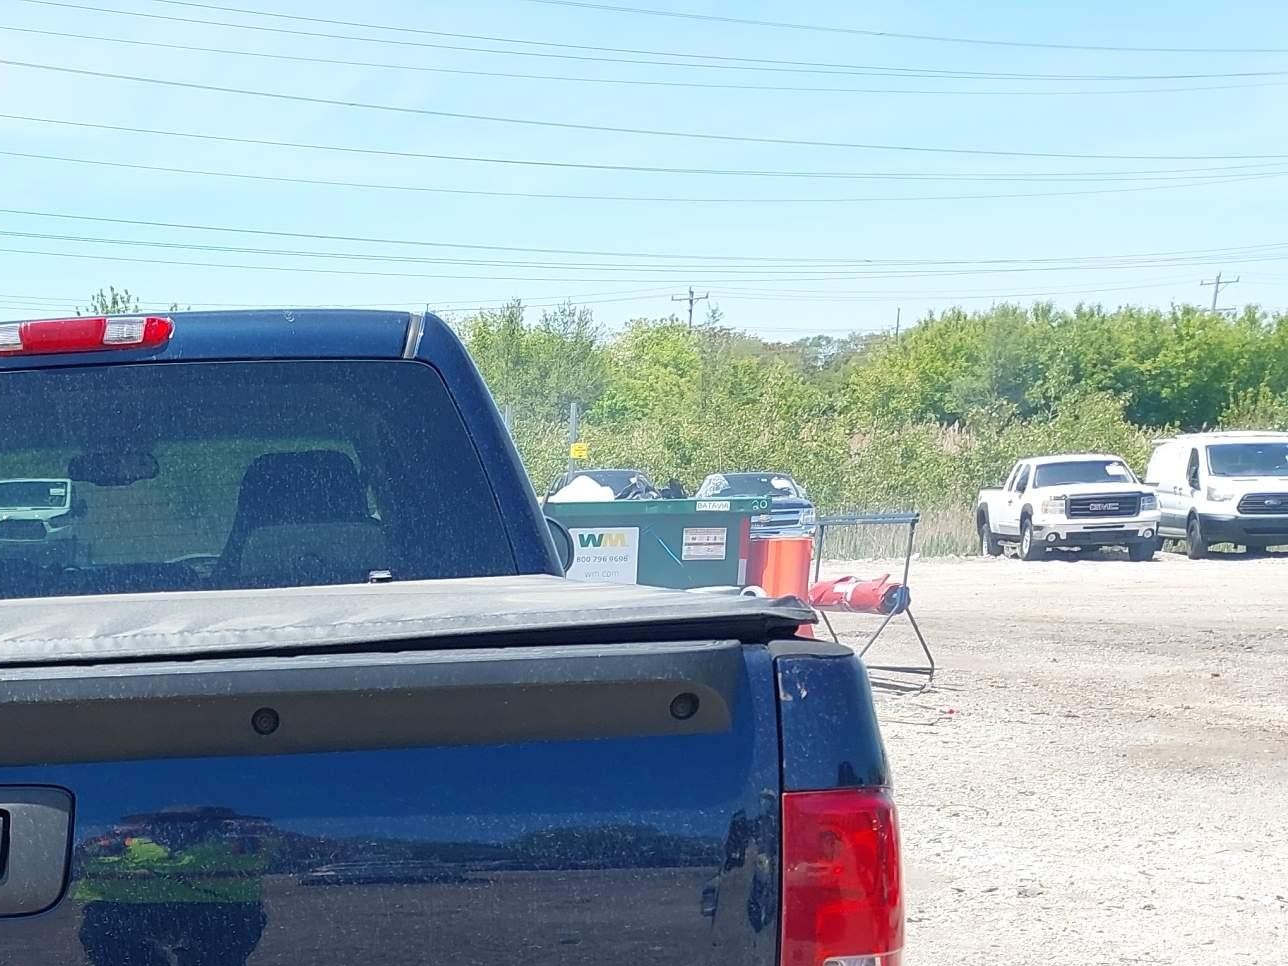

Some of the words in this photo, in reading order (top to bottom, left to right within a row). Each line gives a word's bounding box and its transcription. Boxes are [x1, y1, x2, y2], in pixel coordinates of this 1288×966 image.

[697, 502, 729, 510] BATAVIA
[1089, 502, 1120, 511] GMC
[578, 533, 626, 548] WM
[576, 555, 591, 563] 800
